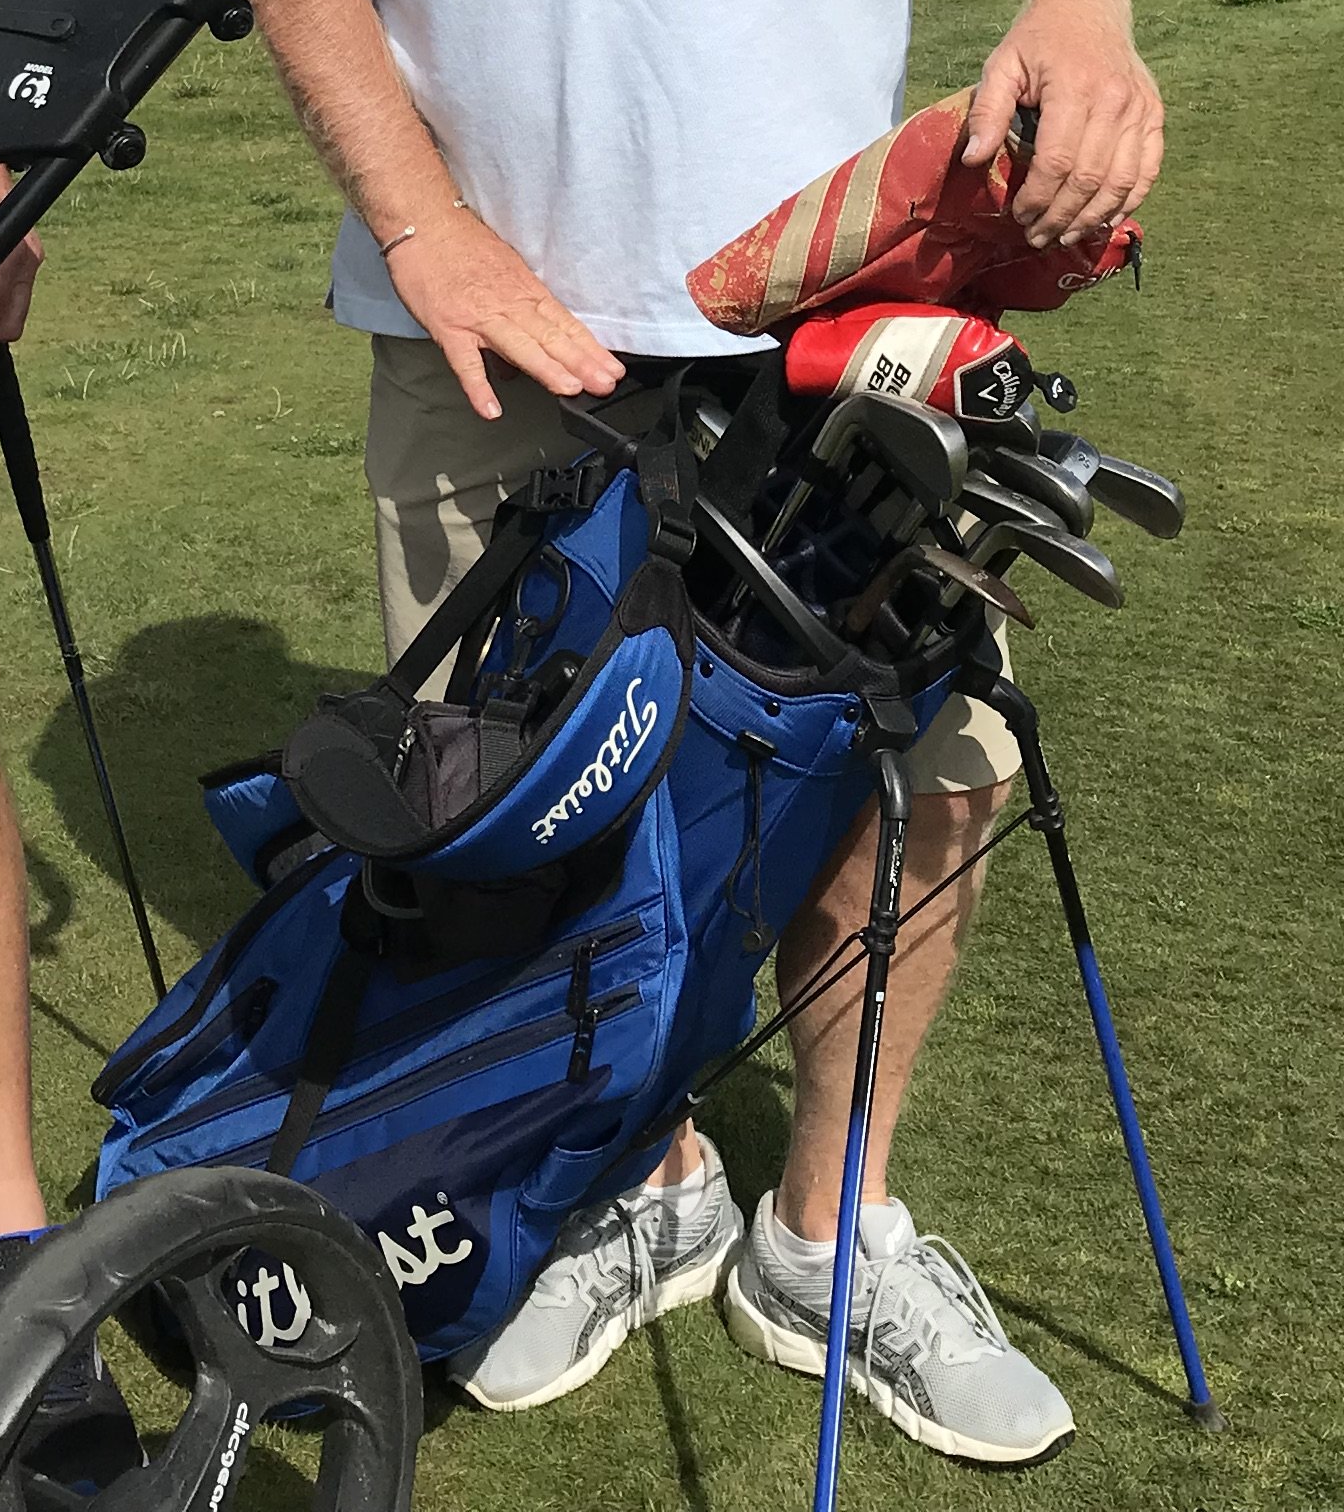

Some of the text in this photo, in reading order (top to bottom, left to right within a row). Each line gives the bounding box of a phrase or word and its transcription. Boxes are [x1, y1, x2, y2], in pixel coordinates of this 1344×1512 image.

[23, 62, 54, 75] MODEL
[992, 360, 1021, 416] Callaway
[531, 677, 658, 841] Titleist
